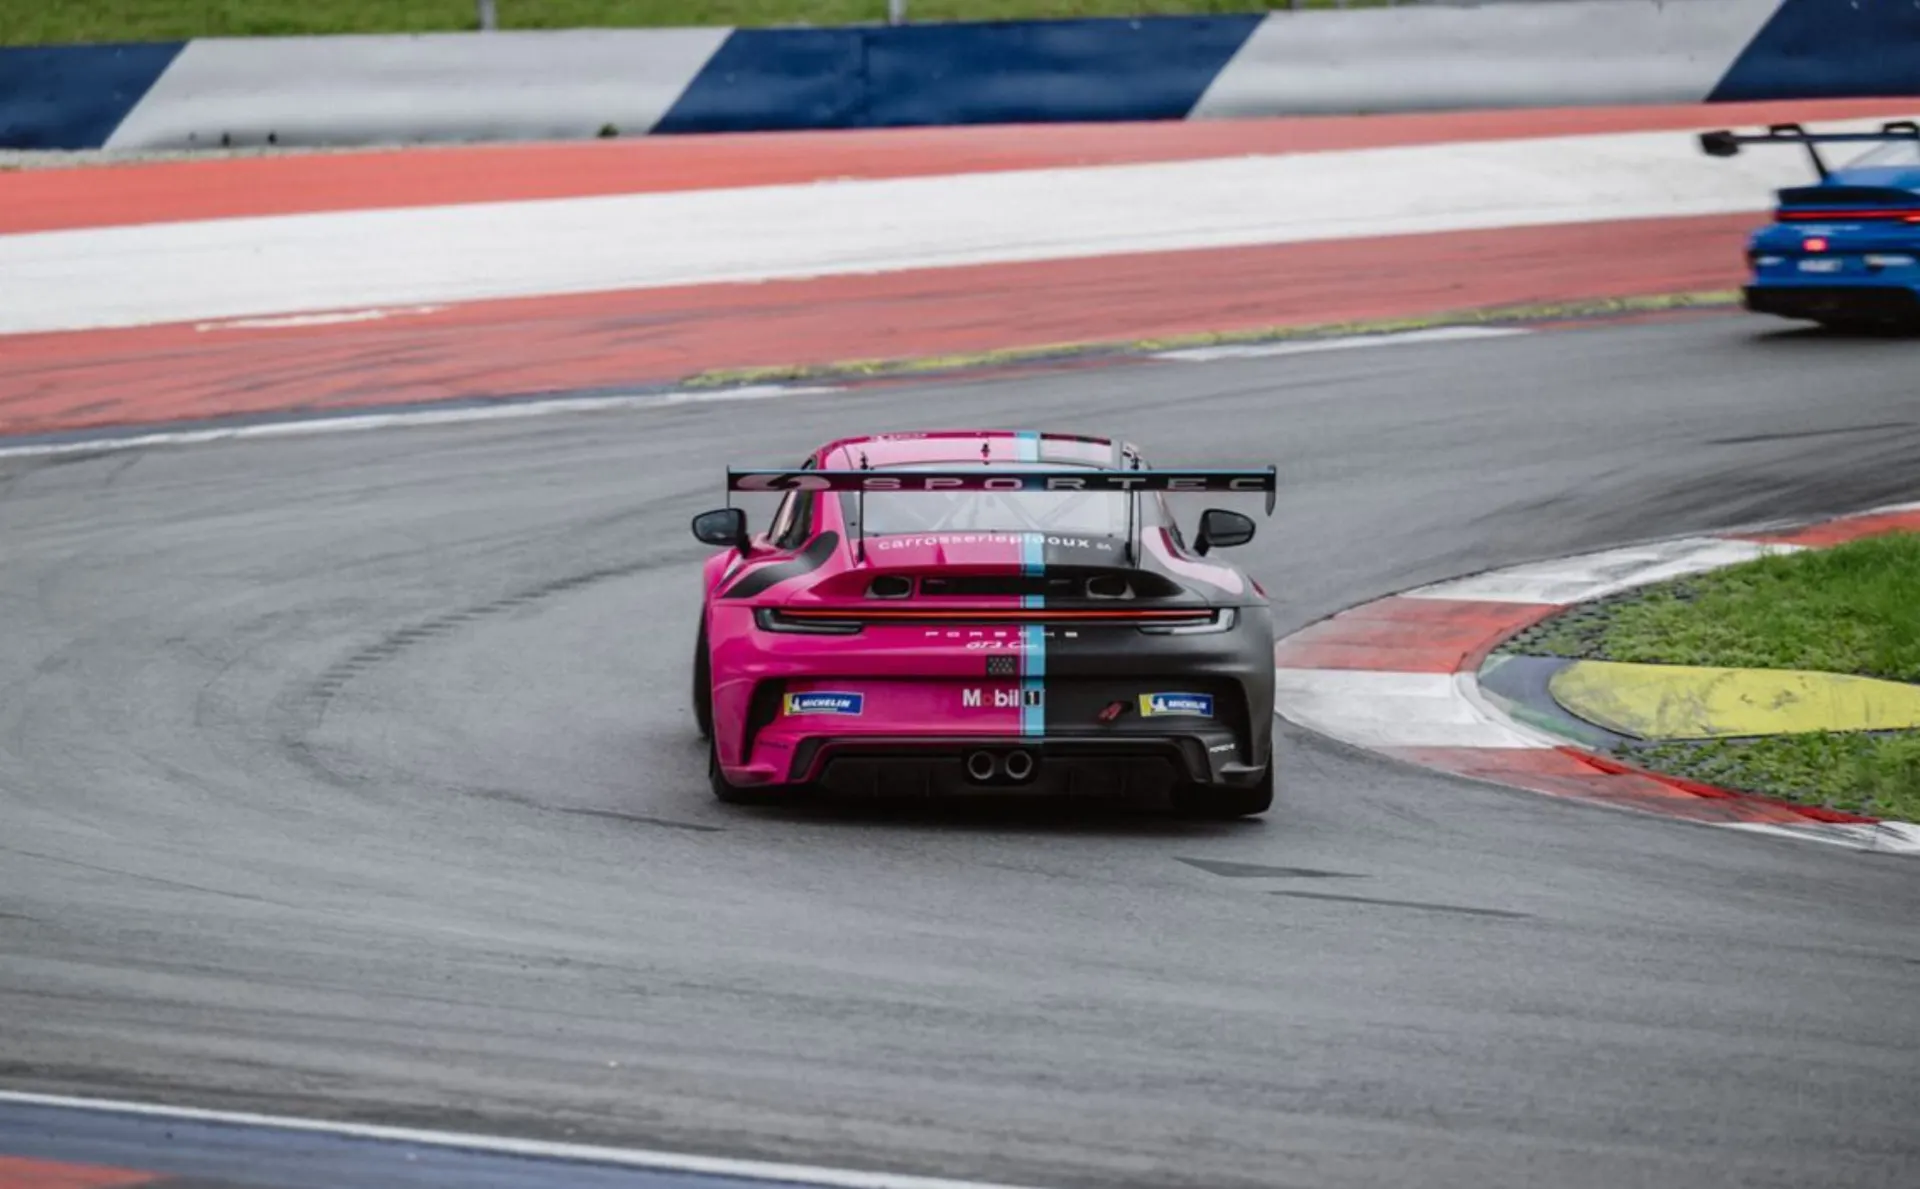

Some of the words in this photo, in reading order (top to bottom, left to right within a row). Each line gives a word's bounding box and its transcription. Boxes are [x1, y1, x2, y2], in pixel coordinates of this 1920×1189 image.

[862, 477, 1265, 490] SPORTEC
[801, 698, 851, 708] MICHELIN
[962, 688, 1019, 707] Mobil
